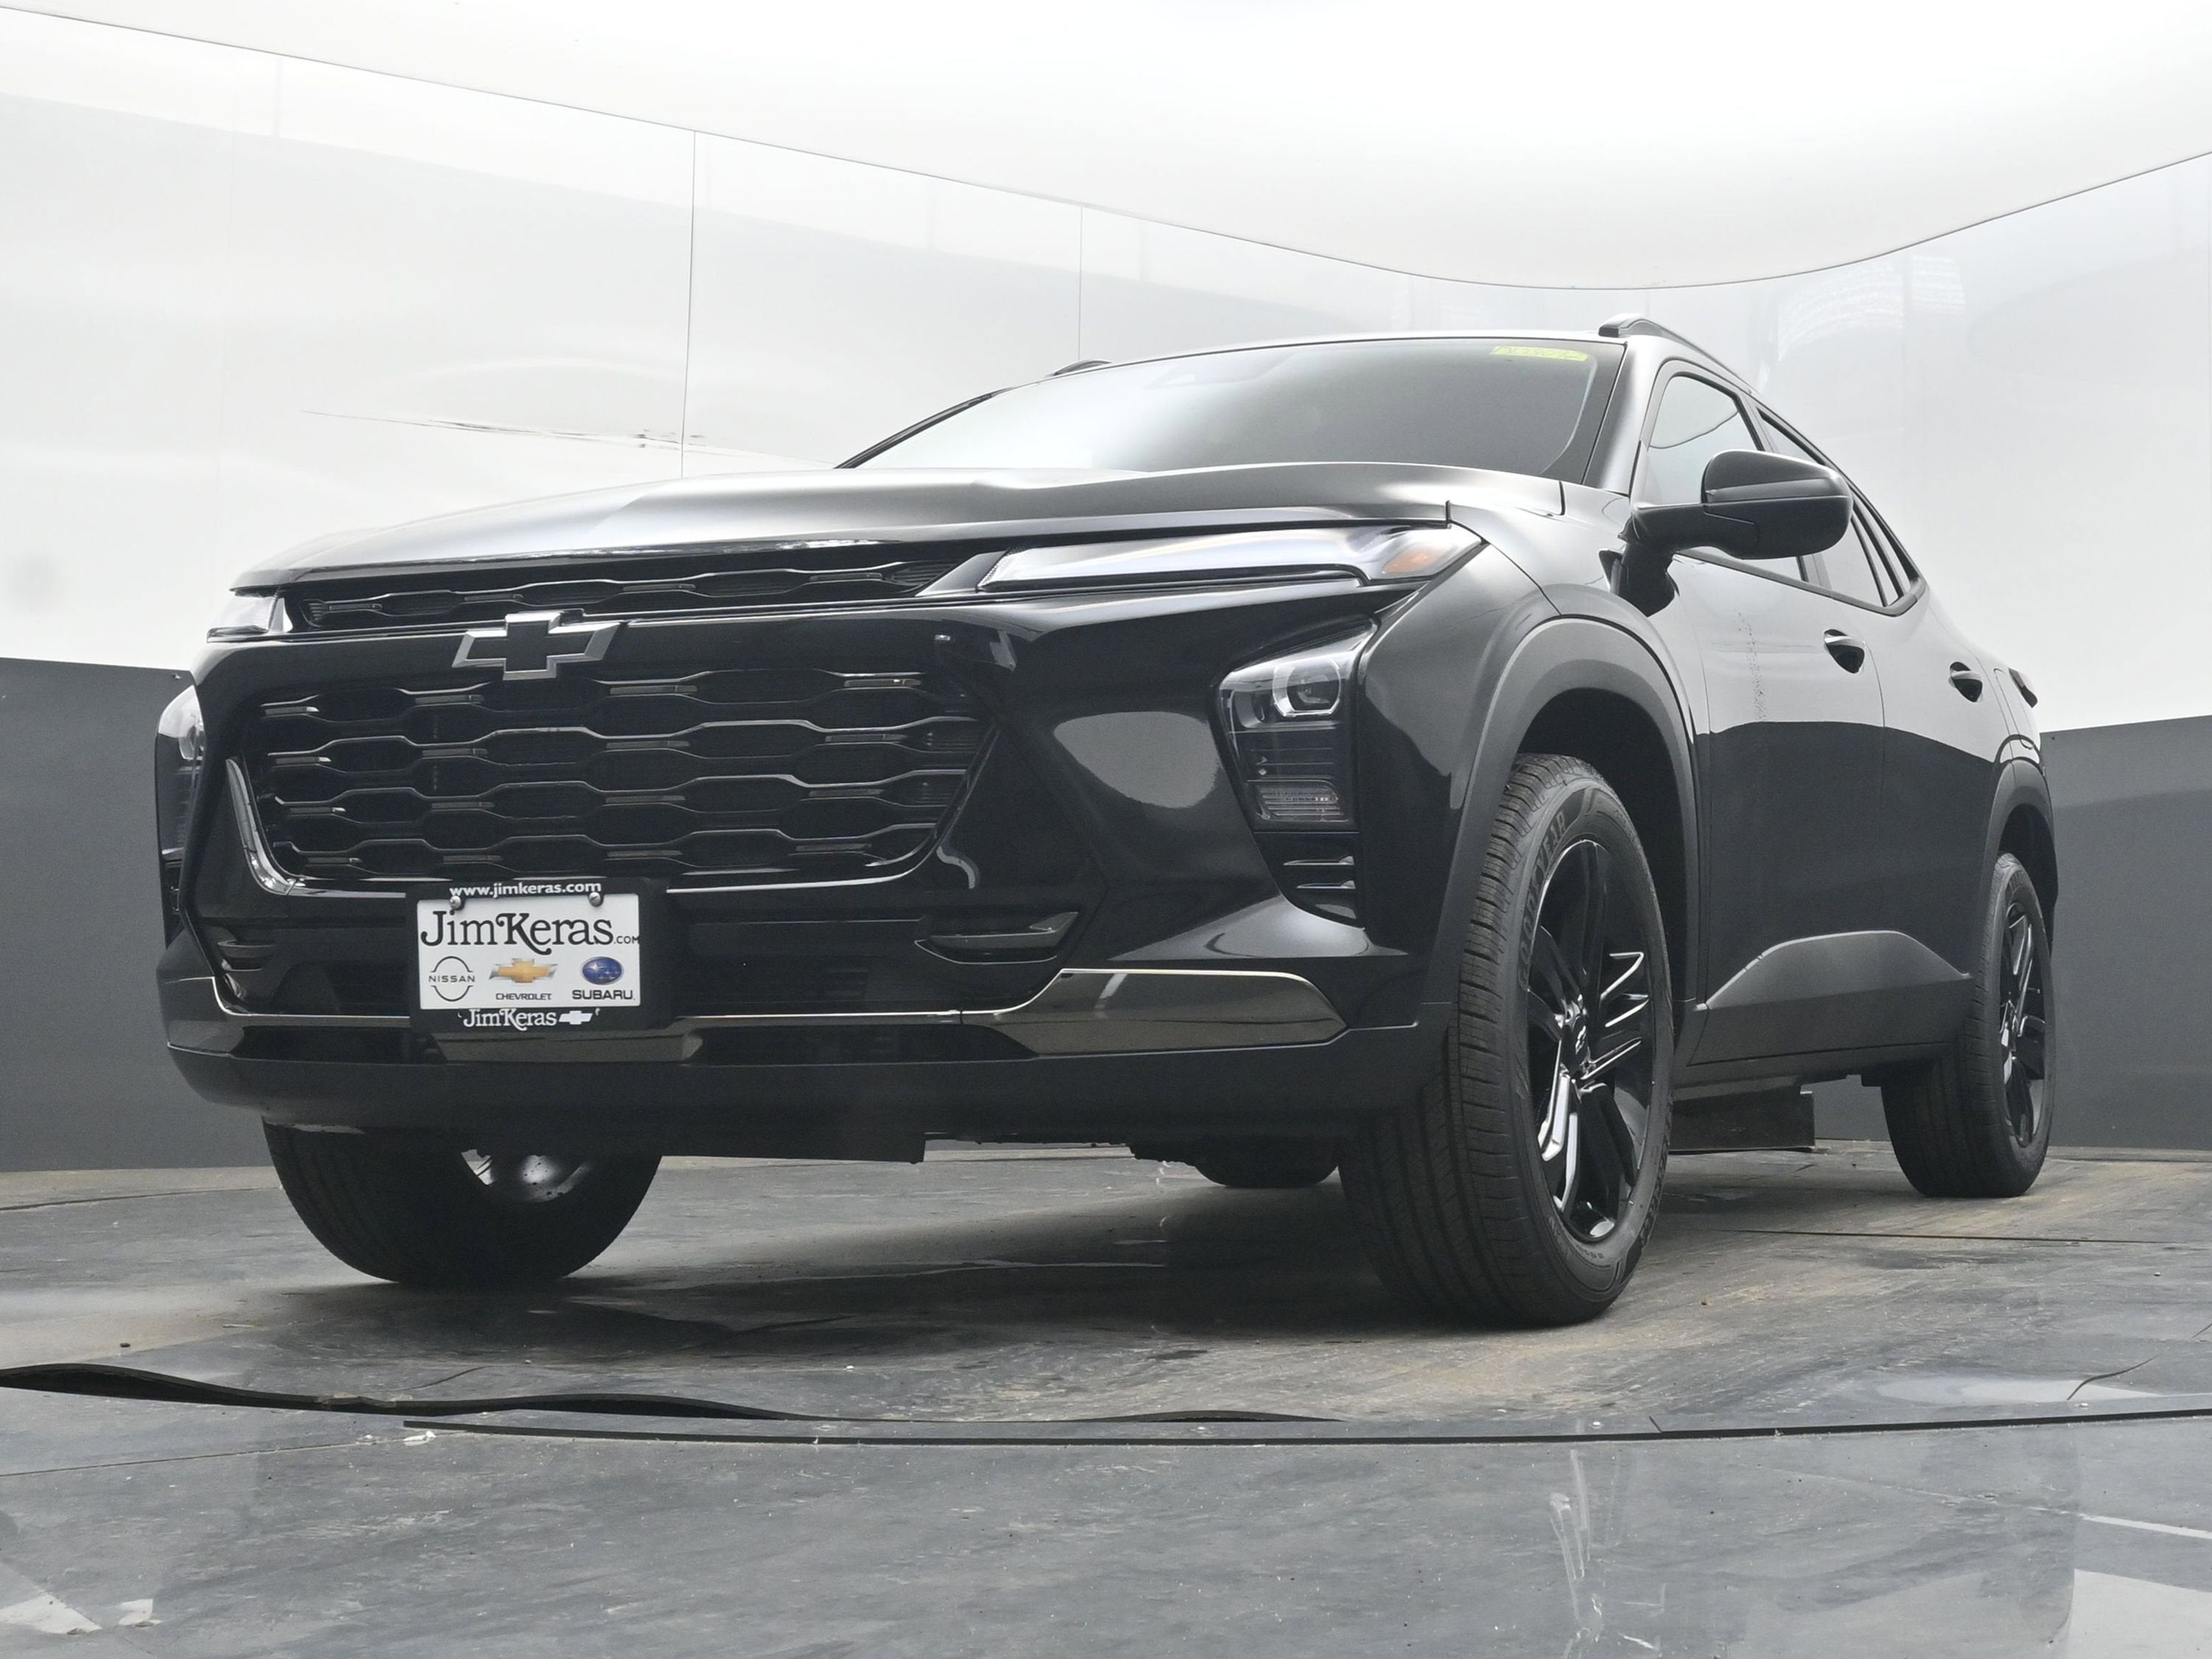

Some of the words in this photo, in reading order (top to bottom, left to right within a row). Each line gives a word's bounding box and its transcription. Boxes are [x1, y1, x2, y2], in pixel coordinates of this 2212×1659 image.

[449, 882, 602, 898] www.jimkeras.com
[428, 975, 475, 983] NISSAN
[495, 992, 552, 1001] CHEVROLET
[571, 990, 633, 1001] SUBARU
